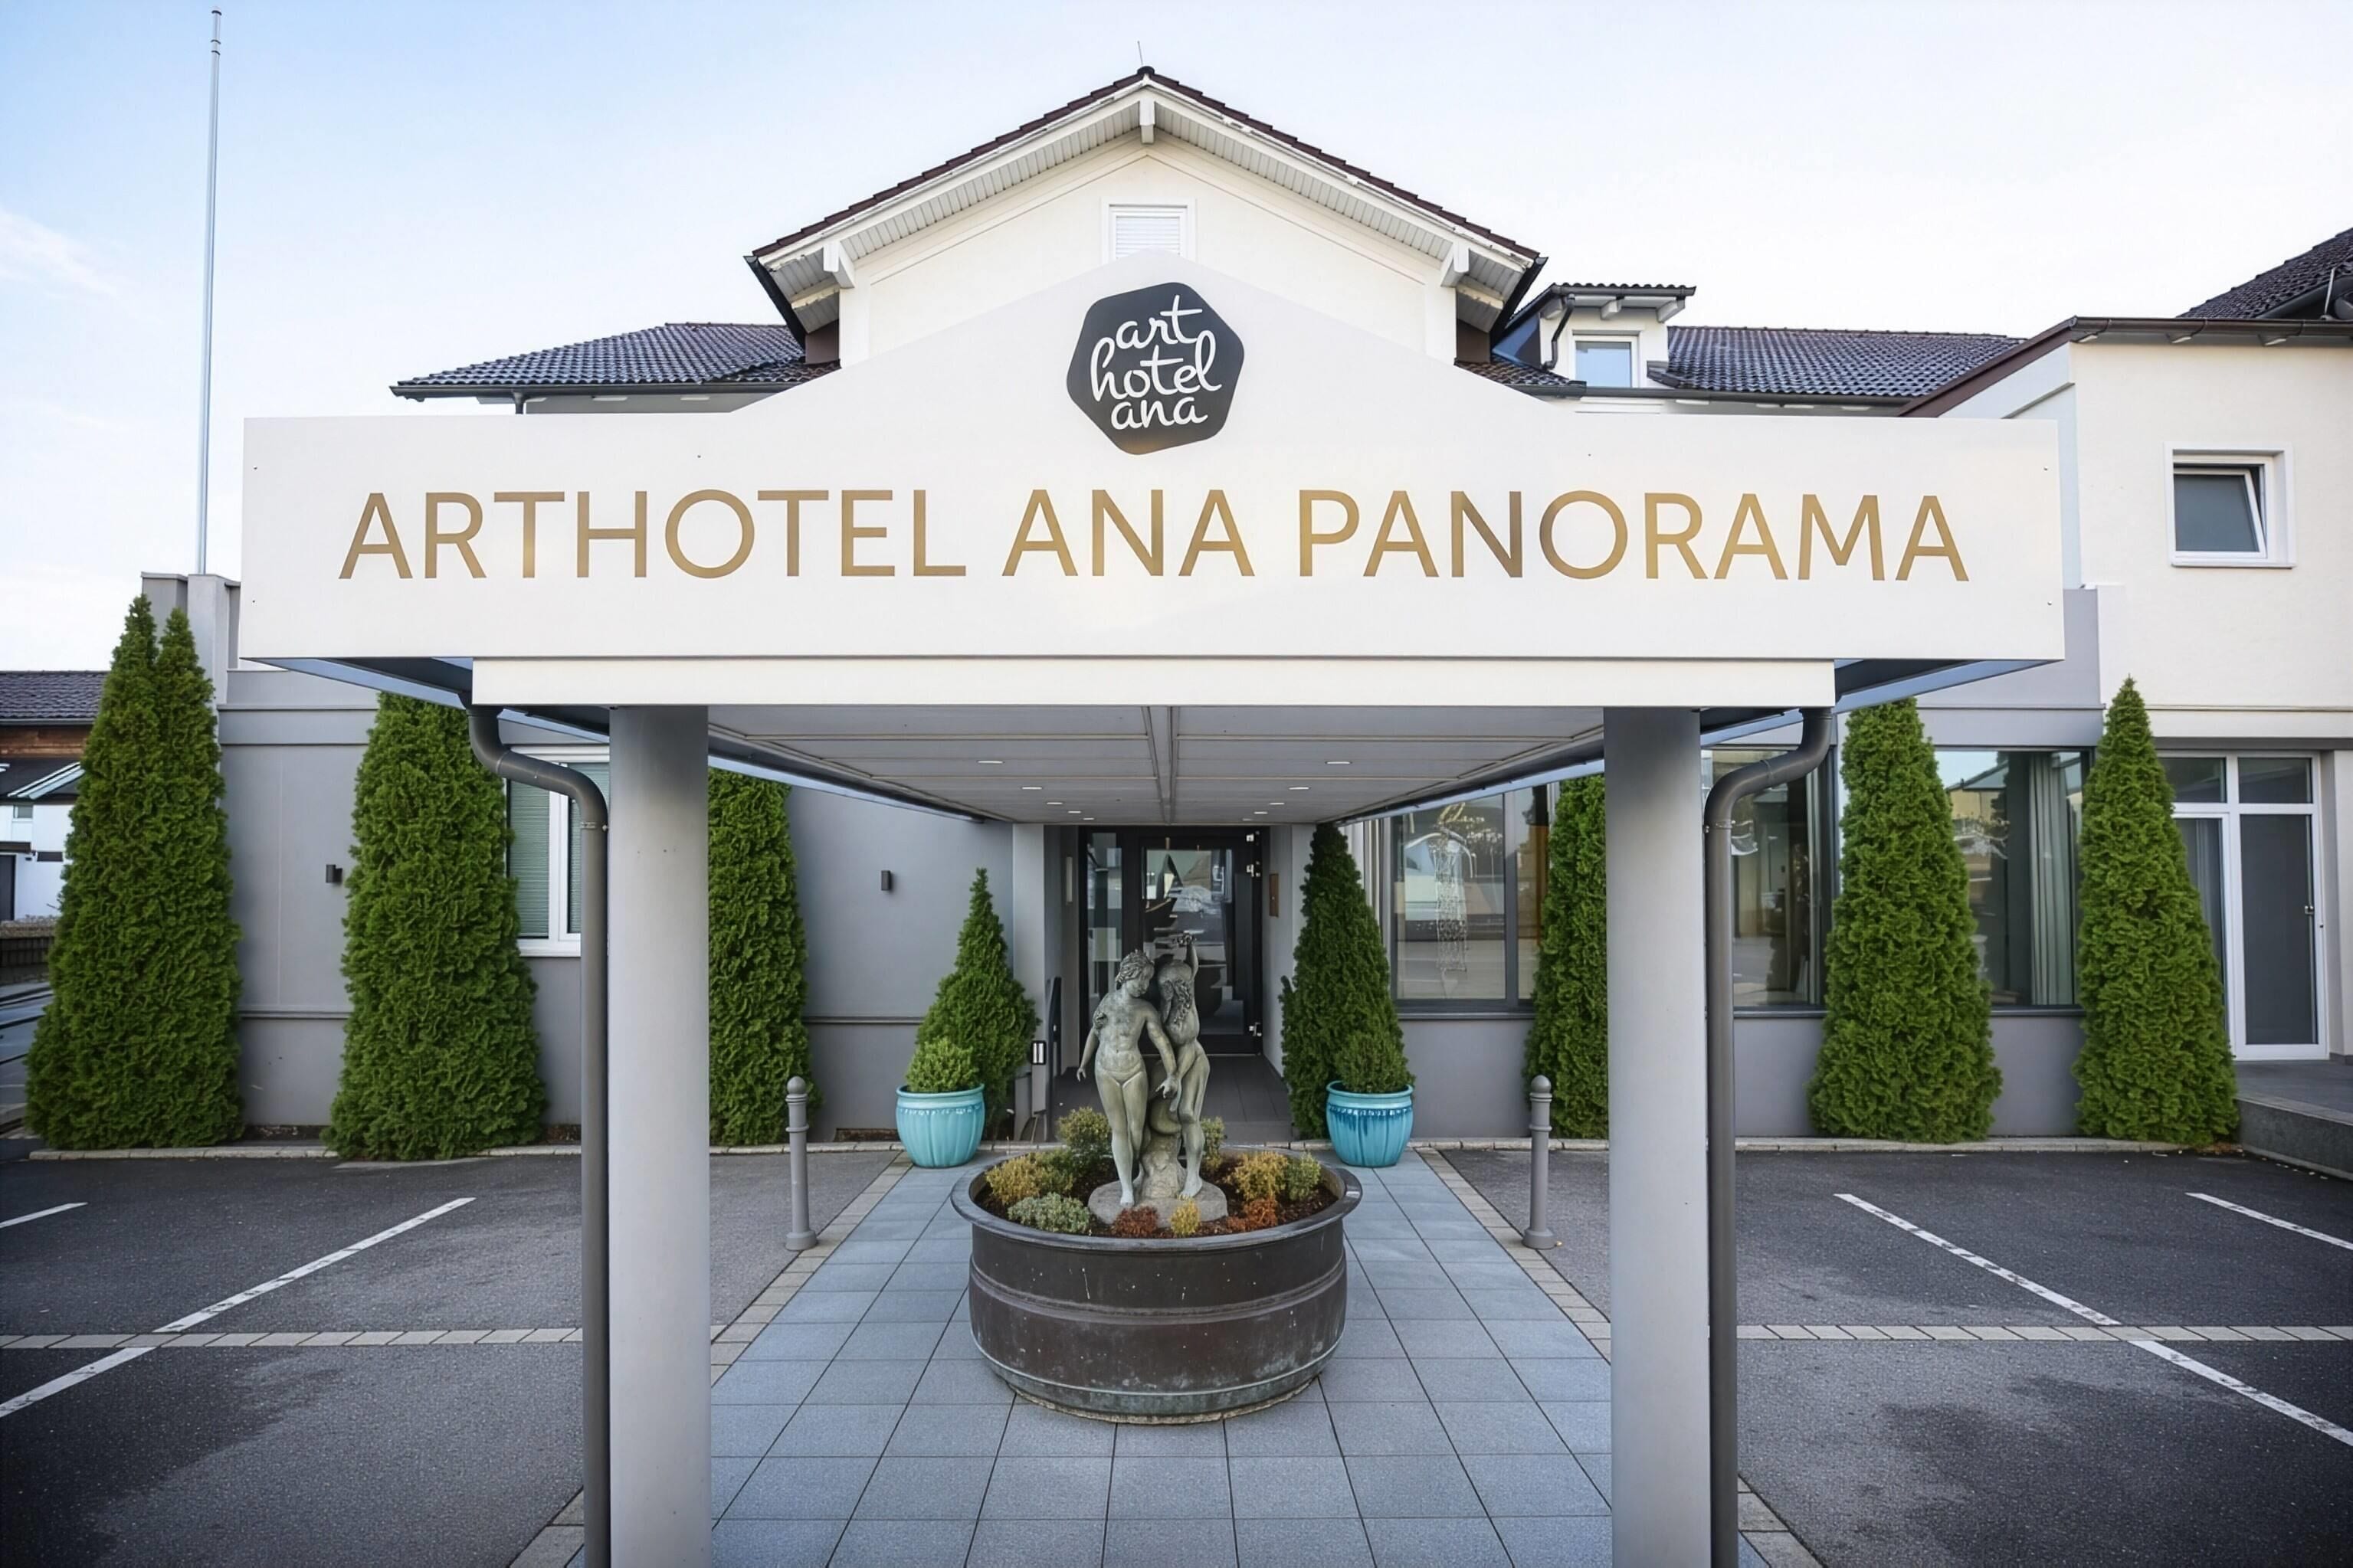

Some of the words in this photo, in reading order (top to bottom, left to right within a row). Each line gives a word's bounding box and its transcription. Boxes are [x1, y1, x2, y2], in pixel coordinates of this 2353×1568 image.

[1116, 295, 1202, 349] art
[1090, 330, 1221, 401] hotel
[1111, 397, 1208, 430] ana
[339, 489, 965, 578] ARTHOTEL
[1002, 489, 1254, 578] ANA
[1299, 490, 1968, 581] PANORAMA
